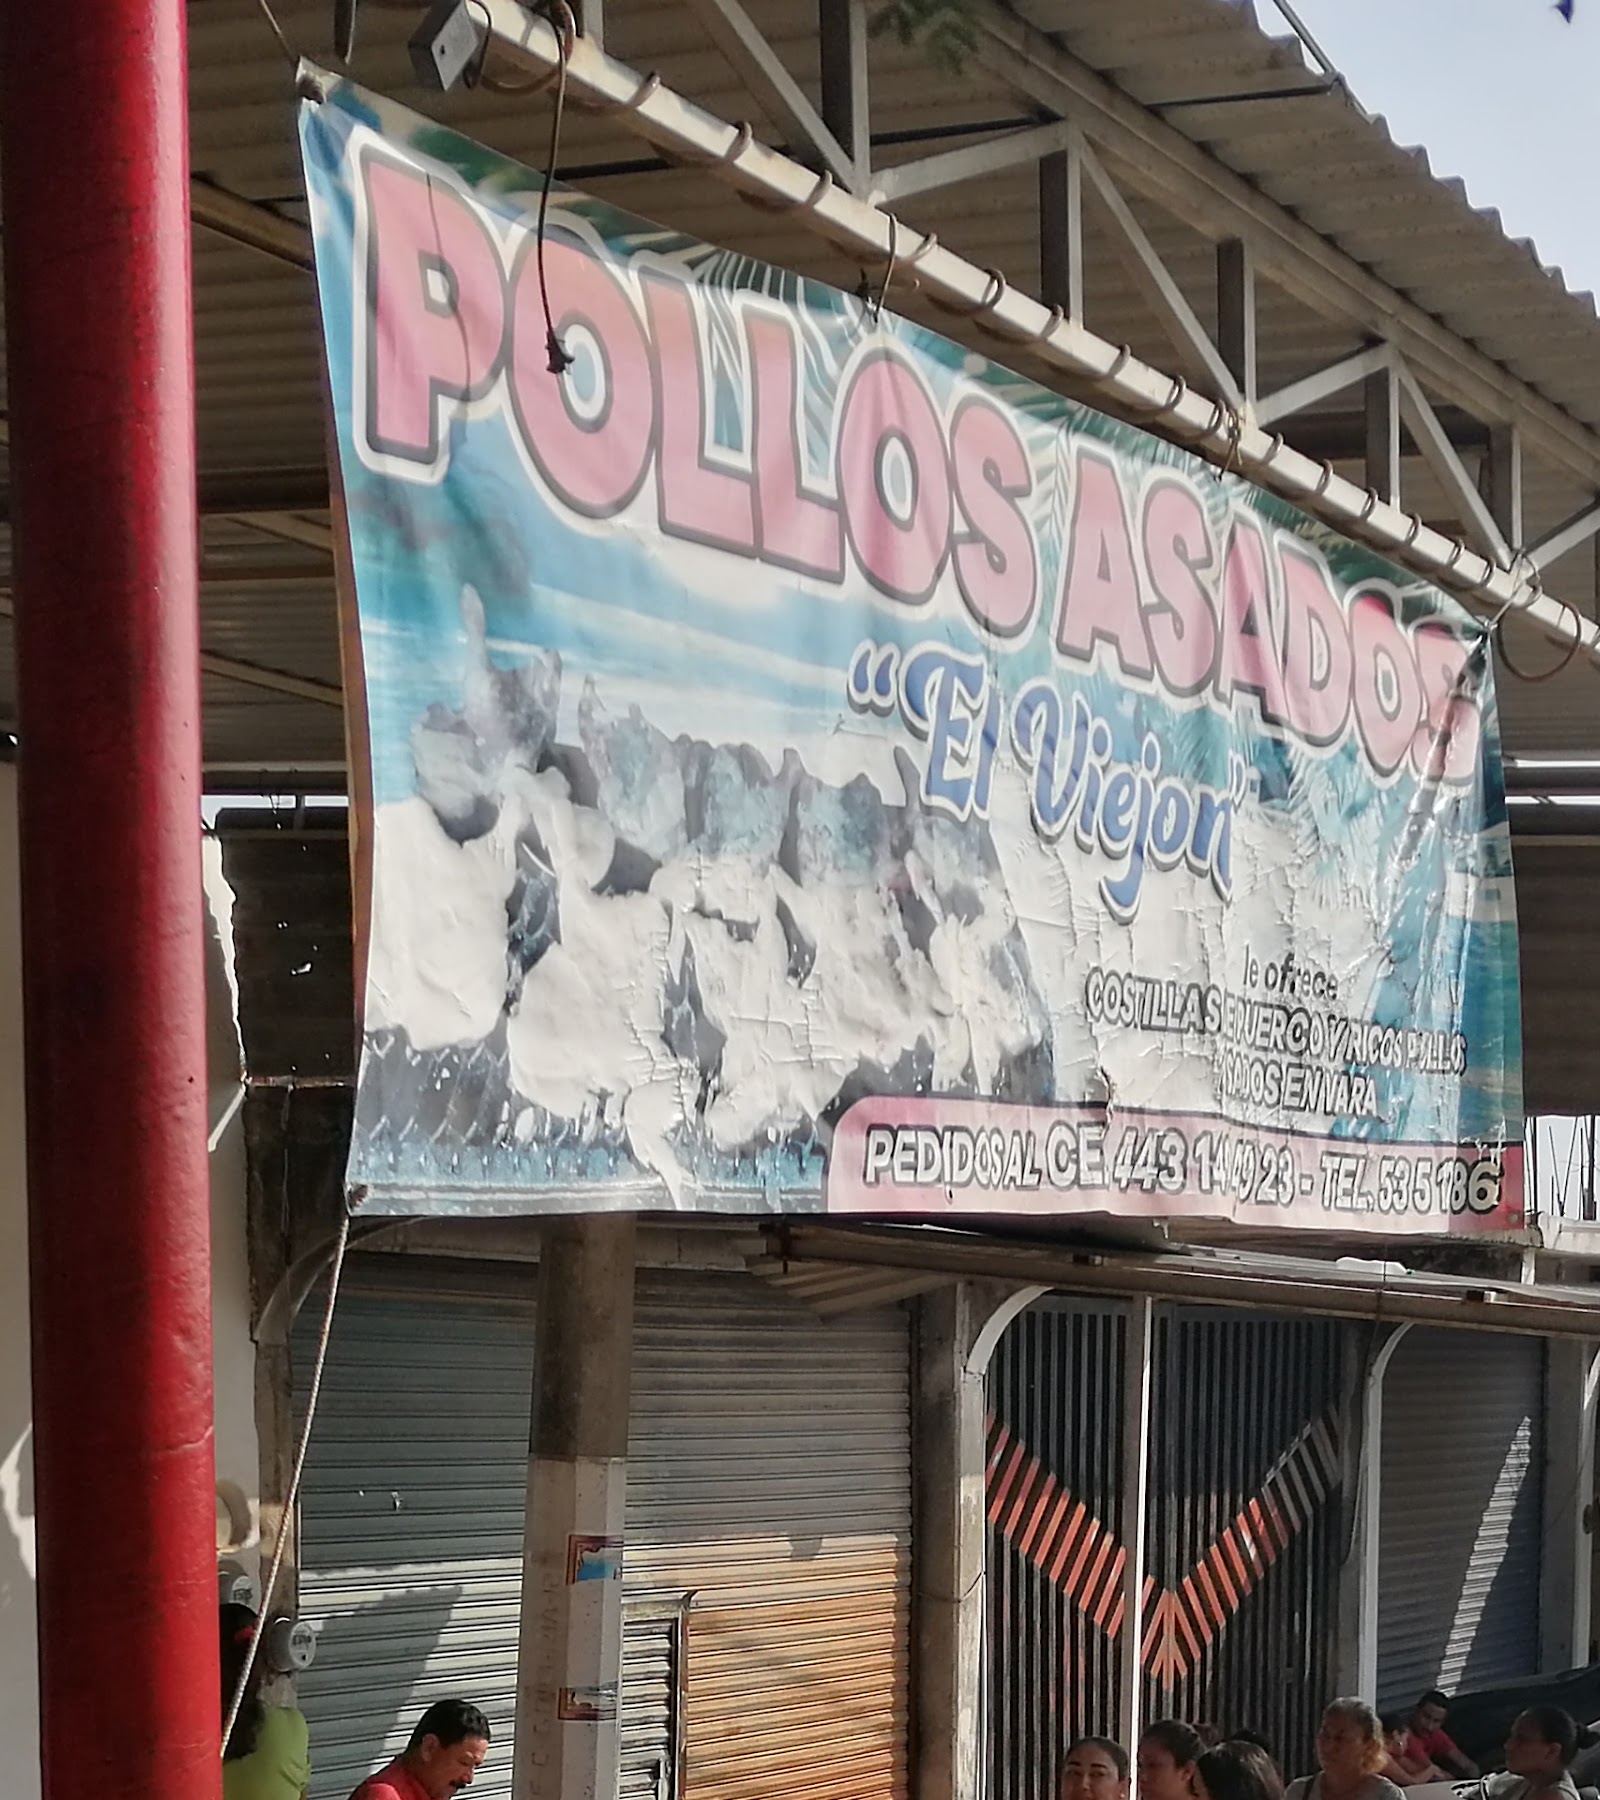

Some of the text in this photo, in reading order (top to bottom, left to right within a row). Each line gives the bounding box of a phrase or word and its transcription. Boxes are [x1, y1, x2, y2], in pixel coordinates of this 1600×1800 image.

[357, 140, 1483, 782] POLLOS ASADOS
[1243, 944, 1338, 1001] le ofrece
[1085, 966, 1222, 1033] COSTILLAS
[1327, 1014, 1349, 1061] Y
[1344, 1018, 1403, 1069] RICOS
[1220, 1046, 1379, 1118] SADOS EN VARA
[864, 1123, 1002, 1187] PEDIDOS
[1002, 1131, 1041, 1190] AL
[1113, 1126, 1187, 1194] 443
[1256, 1143, 1295, 1208] 23
